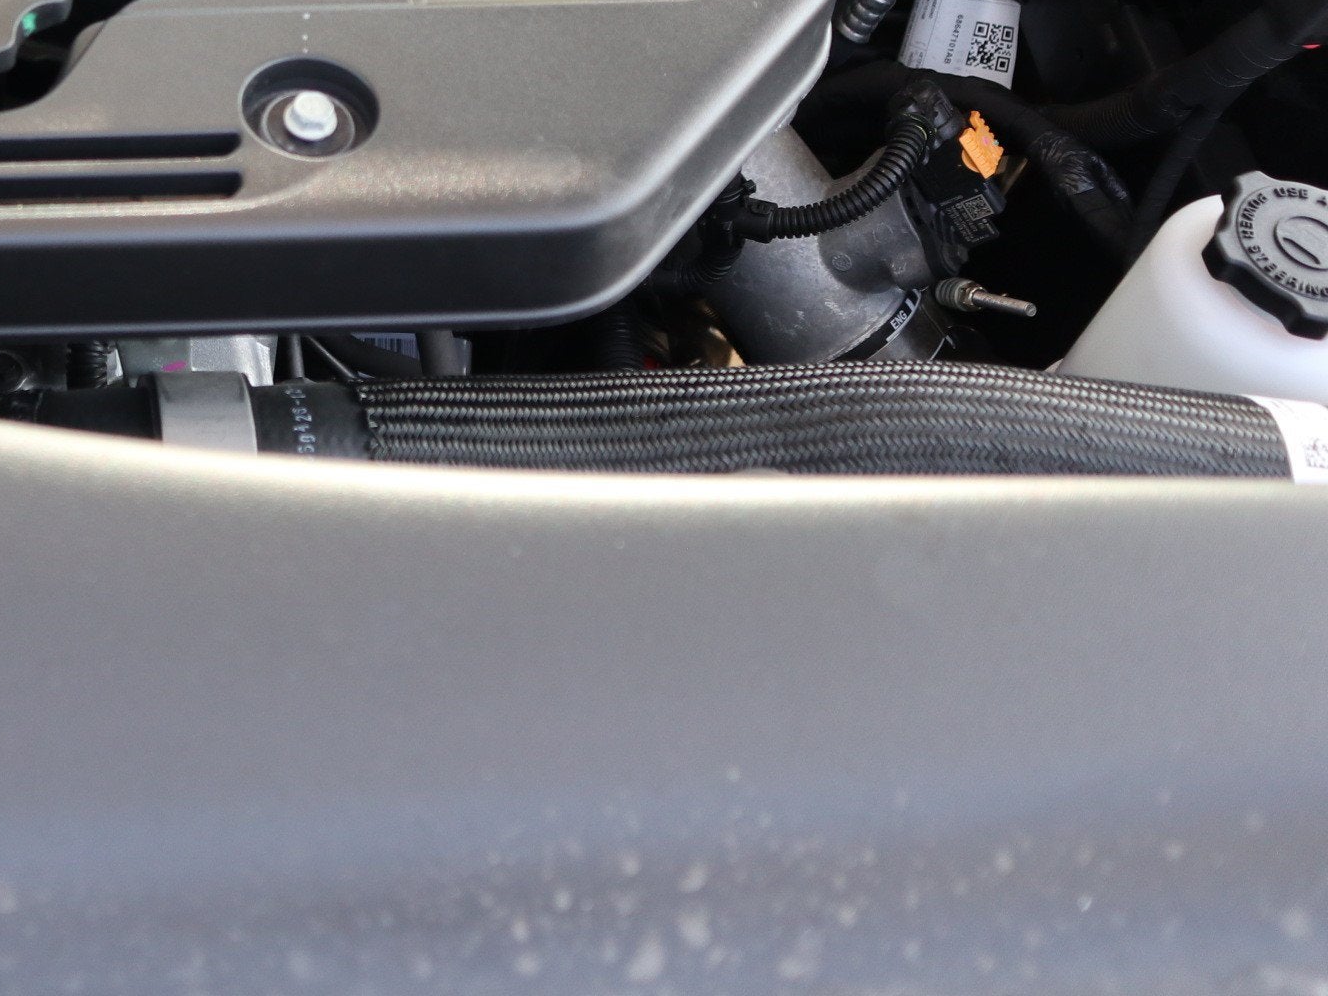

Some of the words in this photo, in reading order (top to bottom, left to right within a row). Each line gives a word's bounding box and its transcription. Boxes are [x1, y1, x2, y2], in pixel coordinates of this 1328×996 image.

[1273, 187, 1309, 200] USE
[1240, 192, 1269, 240] POWER
[890, 310, 908, 330] ENG
